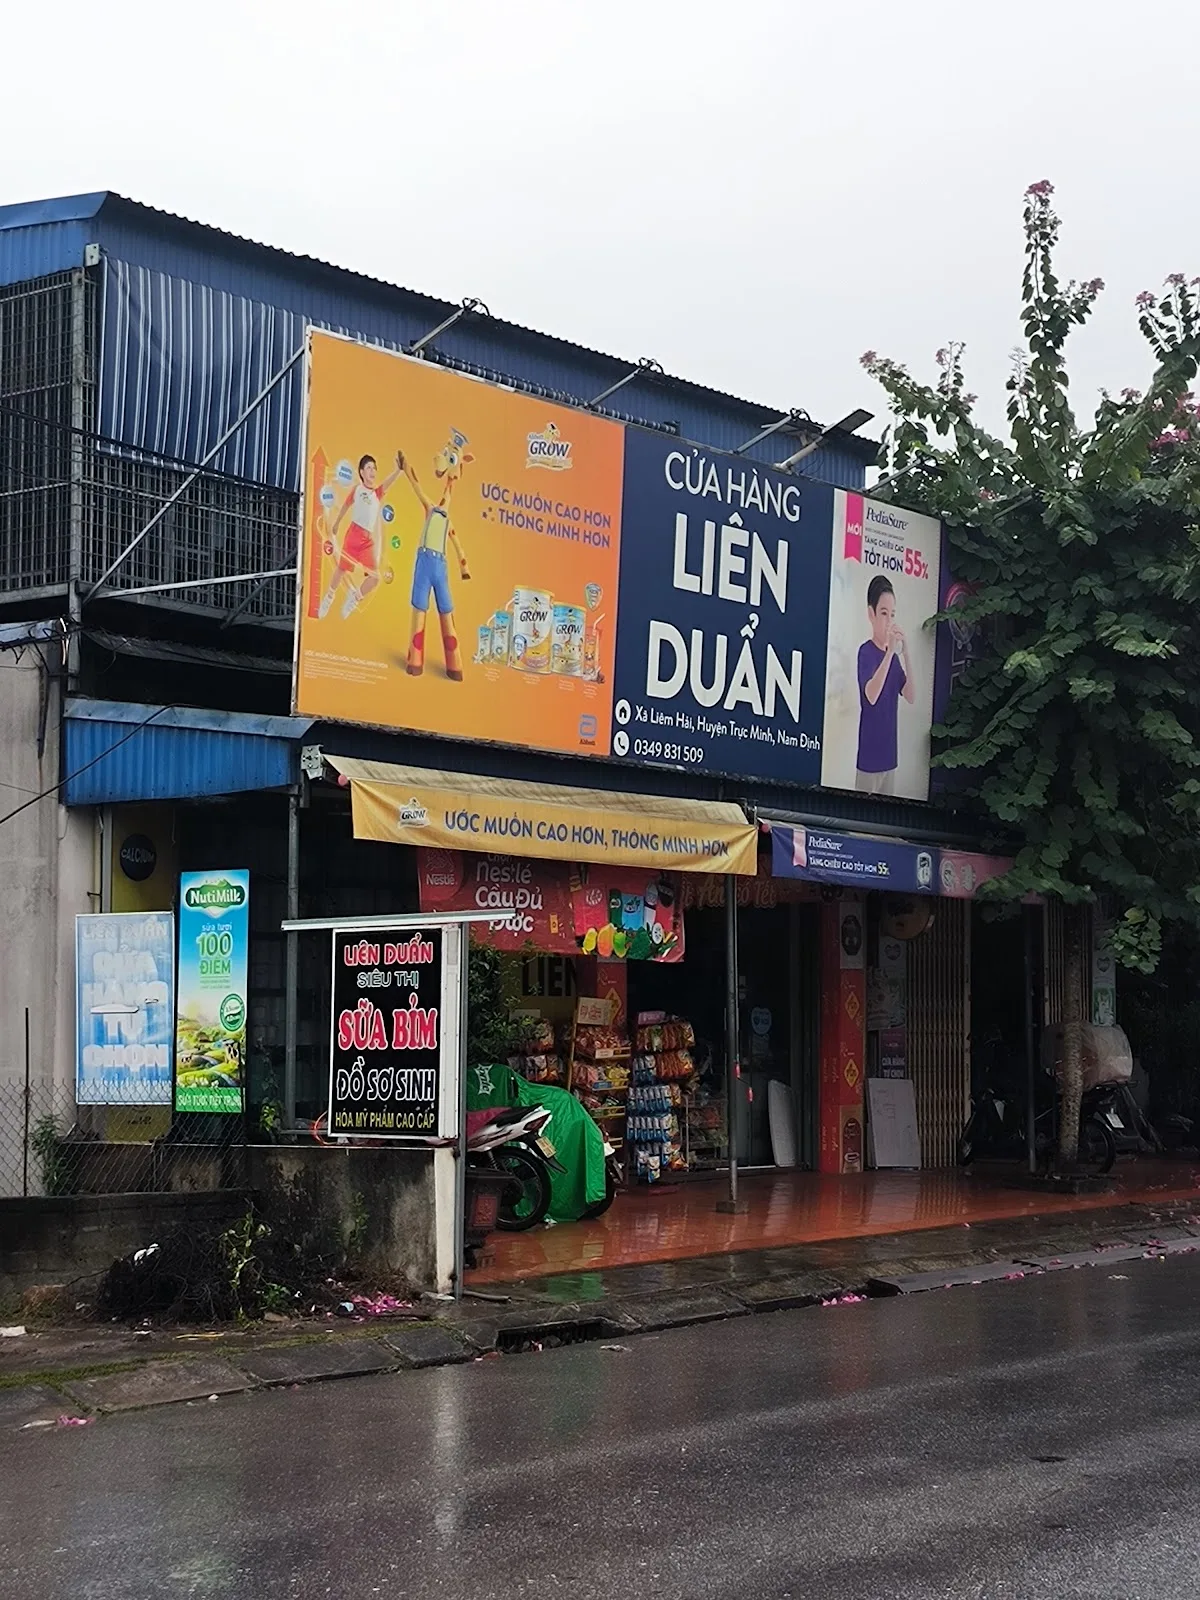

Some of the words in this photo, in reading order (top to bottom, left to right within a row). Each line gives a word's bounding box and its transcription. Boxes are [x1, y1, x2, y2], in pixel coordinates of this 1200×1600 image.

[530, 441, 569, 457] GROW
[665, 449, 722, 502] CỬA
[727, 469, 801, 522] HÀNG
[555, 503, 581, 522] CAO
[866, 507, 908, 530] PediaSure
[546, 520, 580, 543] MINH
[673, 511, 789, 614] LIÊN
[864, 547, 881, 567] TỐT
[904, 547, 929, 580] 55%
[646, 612, 803, 724] DUẨN
[650, 709, 674, 727] Liêm
[697, 716, 728, 739] Huyện
[729, 720, 748, 741] Trực
[777, 729, 798, 747] Nam
[800, 733, 821, 752] Định
[634, 738, 662, 758] 0349
[664, 744, 681, 760] 831
[683, 747, 704, 764] 509
[401, 809, 426, 821] GROW
[445, 808, 480, 833] ƯỚC
[484, 812, 533, 838] MUỐN
[537, 820, 568, 843] CAO
[611, 828, 660, 851] THÔNG
[662, 835, 698, 856] MINH
[190, 888, 241, 904] NutiMilk
[475, 883, 514, 908] Cầu
[515, 886, 543, 910] Đủ
[196, 931, 234, 958] 100
[344, 939, 380, 966] LIÊN
[384, 932, 433, 965] DUẨN
[357, 968, 392, 988] SIÊU
[394, 970, 419, 989] THỊ
[338, 997, 388, 1050] SỮA
[392, 992, 438, 1050] BỈM
[336, 1056, 365, 1101] ĐỒ
[367, 1067, 394, 1101] SƠ
[395, 1068, 436, 1101] SINH
[335, 1108, 353, 1127] HÓA
[370, 1104, 394, 1128] PHẨM
[396, 1112, 415, 1128] CAO
